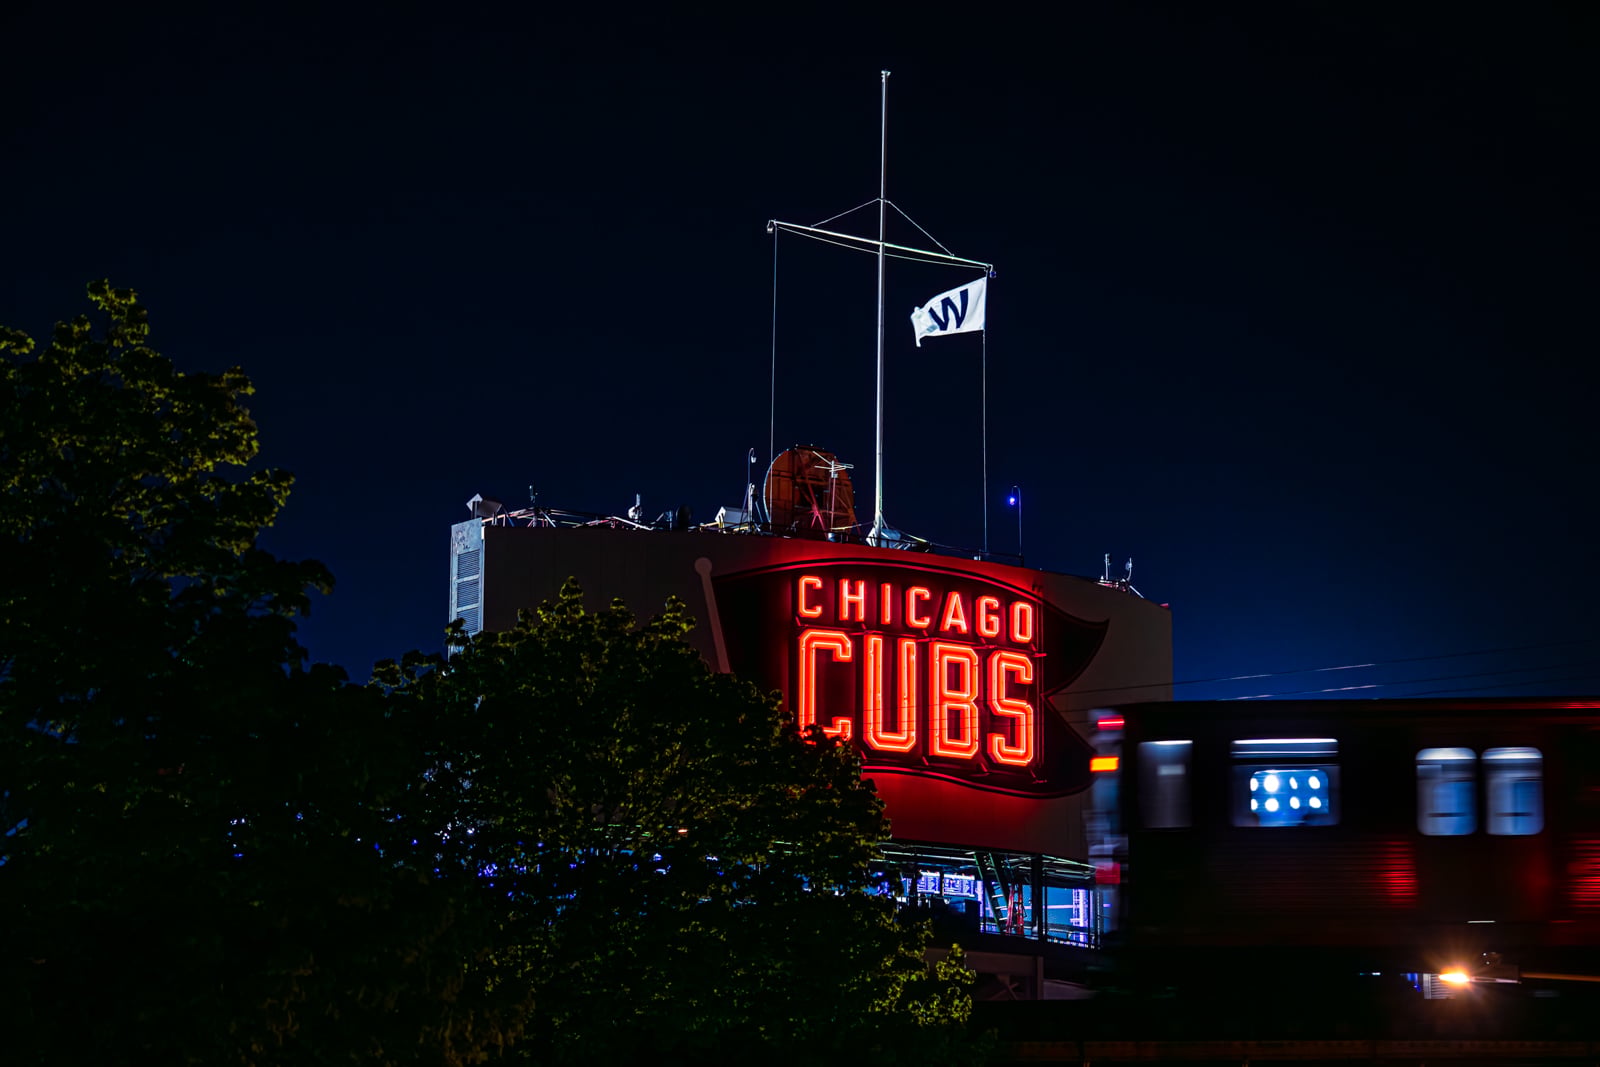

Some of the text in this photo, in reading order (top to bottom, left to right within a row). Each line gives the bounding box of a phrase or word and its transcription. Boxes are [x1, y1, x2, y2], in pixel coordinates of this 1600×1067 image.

[928, 288, 969, 331] W
[798, 575, 1034, 644] CHICAGO
[798, 629, 1034, 766] CUBS
